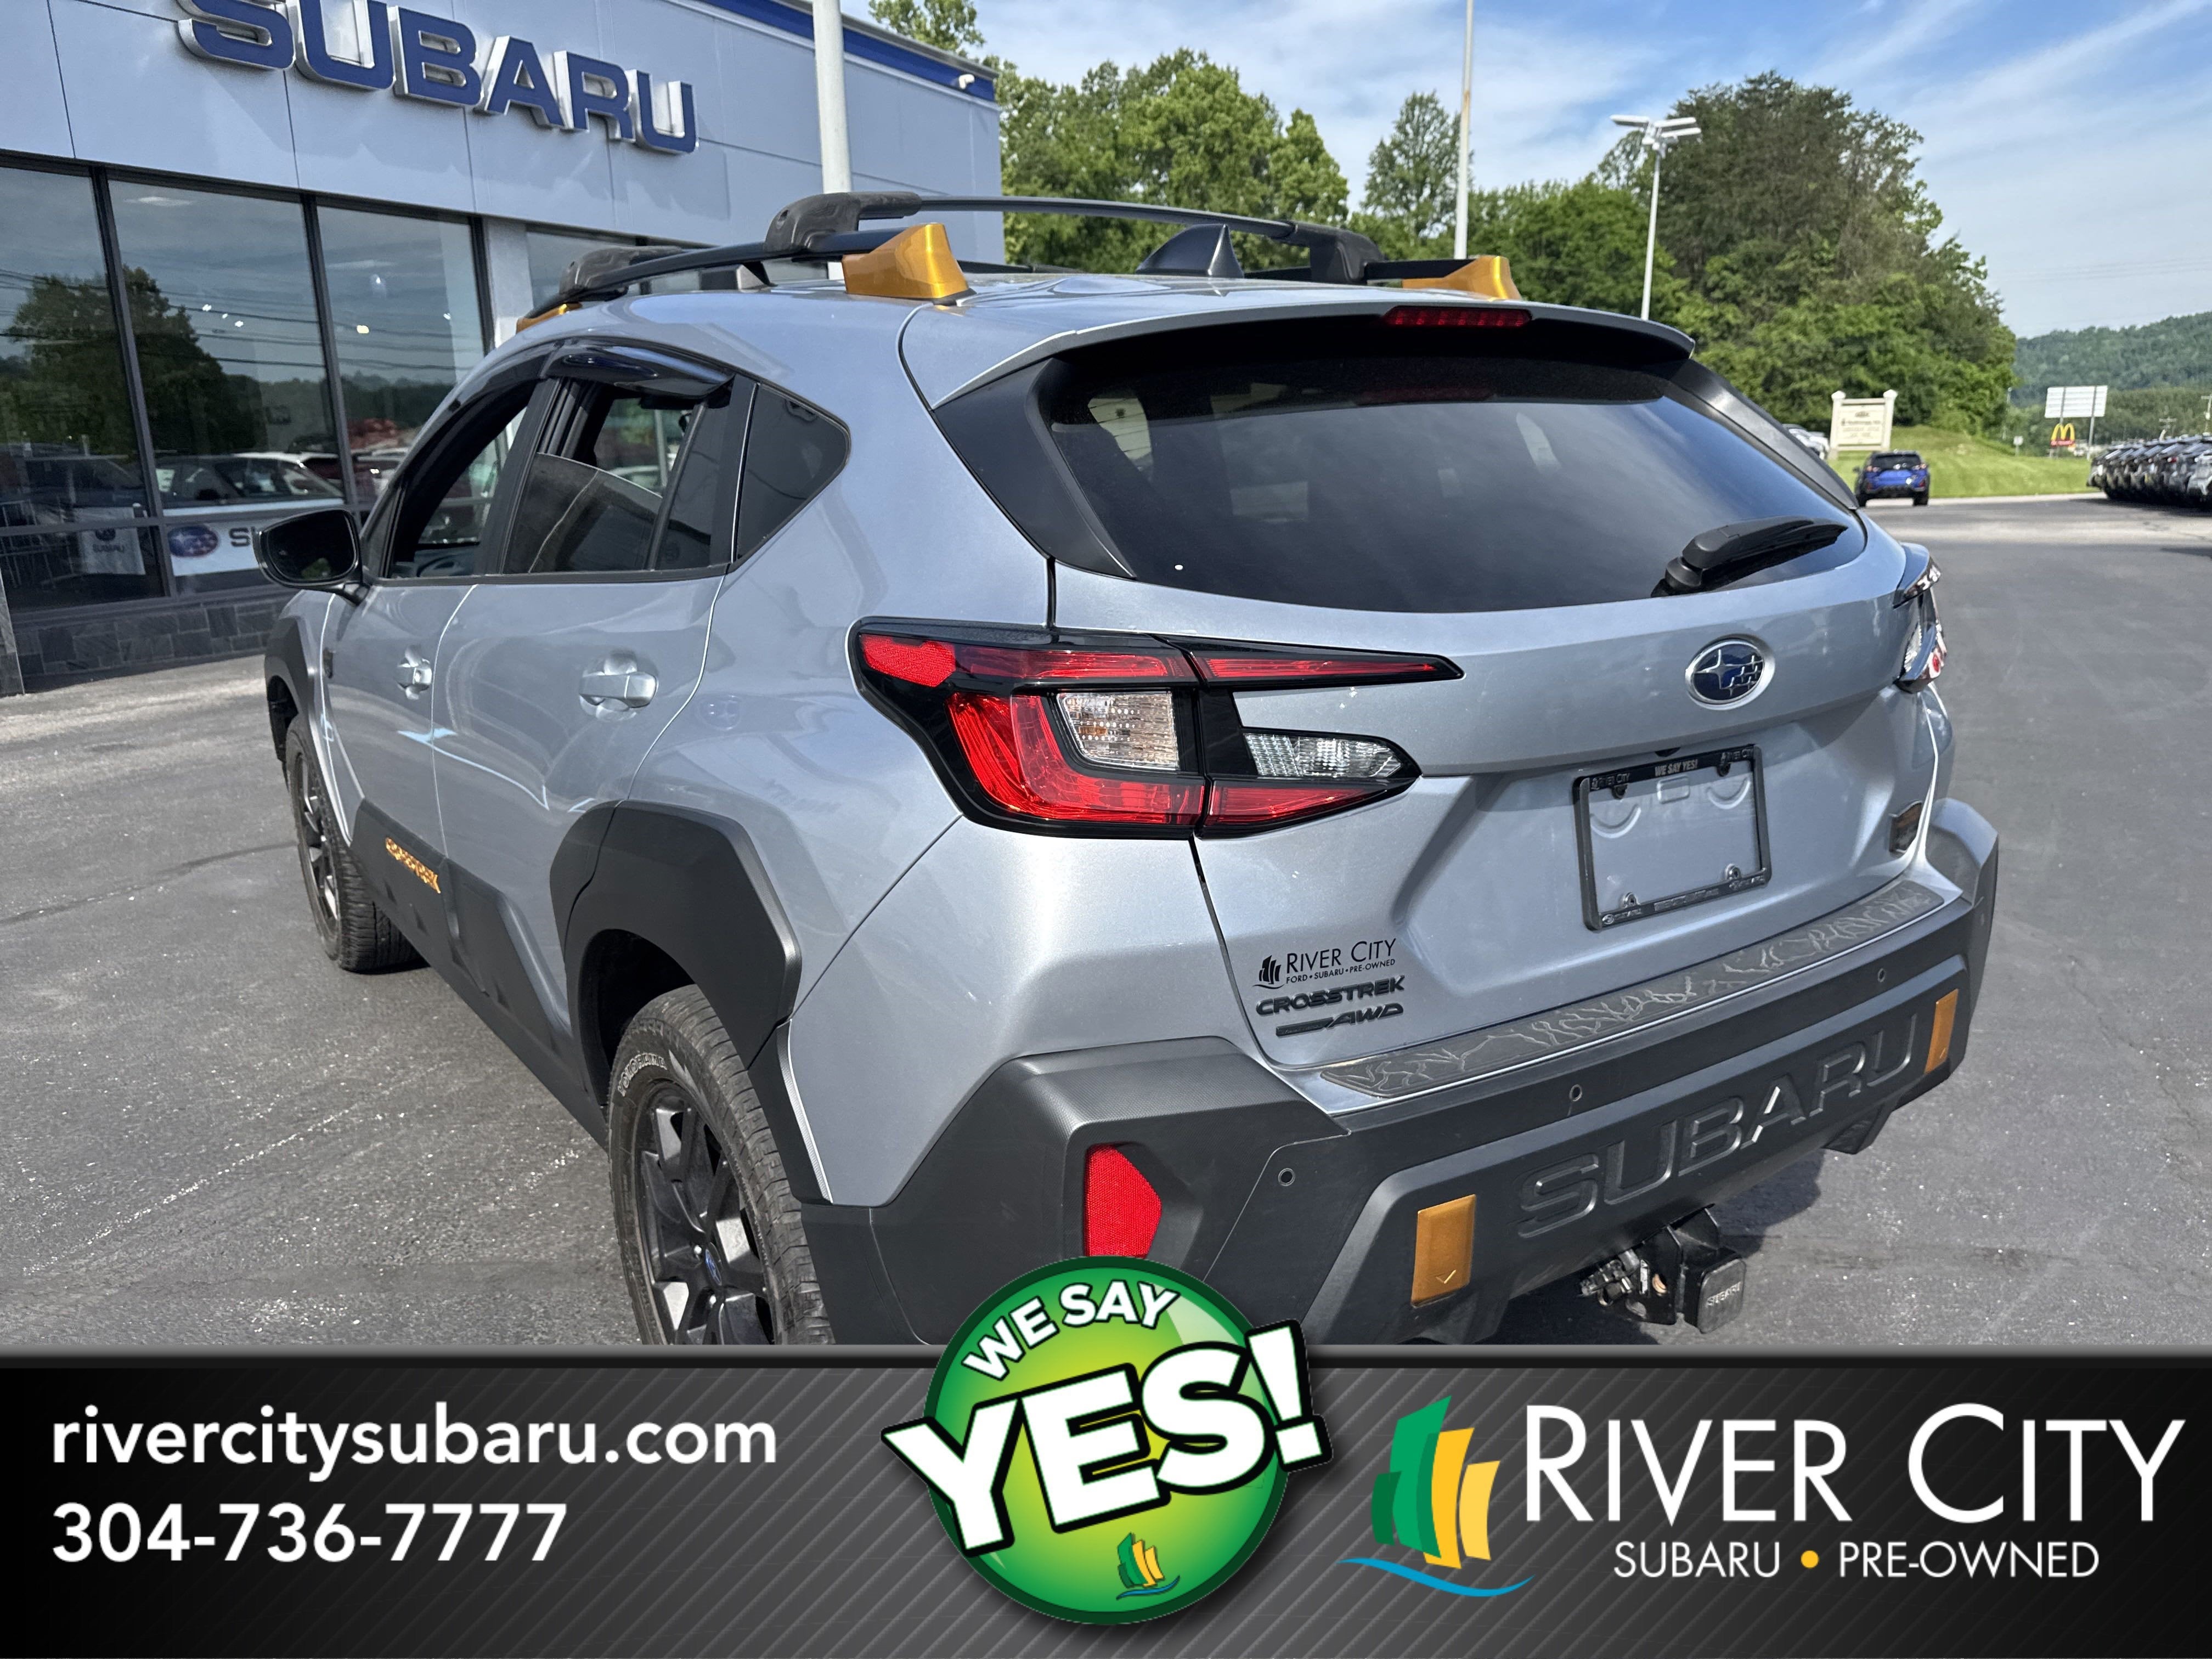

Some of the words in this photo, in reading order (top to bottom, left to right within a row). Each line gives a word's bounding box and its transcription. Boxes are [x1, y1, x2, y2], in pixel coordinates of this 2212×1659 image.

[177, 0, 699, 154] SUBARU
[1655, 766, 1666, 777] WE
[1667, 761, 1681, 775] SAY
[1286, 948, 1341, 974] RIVER
[1351, 938, 1396, 962] CITY
[1286, 974, 1308, 984] FORD
[1314, 968, 1344, 979] SUBARU
[1350, 958, 1396, 973] PRE-OWNED
[1256, 975, 1405, 1015] CROSSTREK
[1326, 1003, 1404, 1028] AWD
[1518, 1013, 1918, 1239] SUBARU
